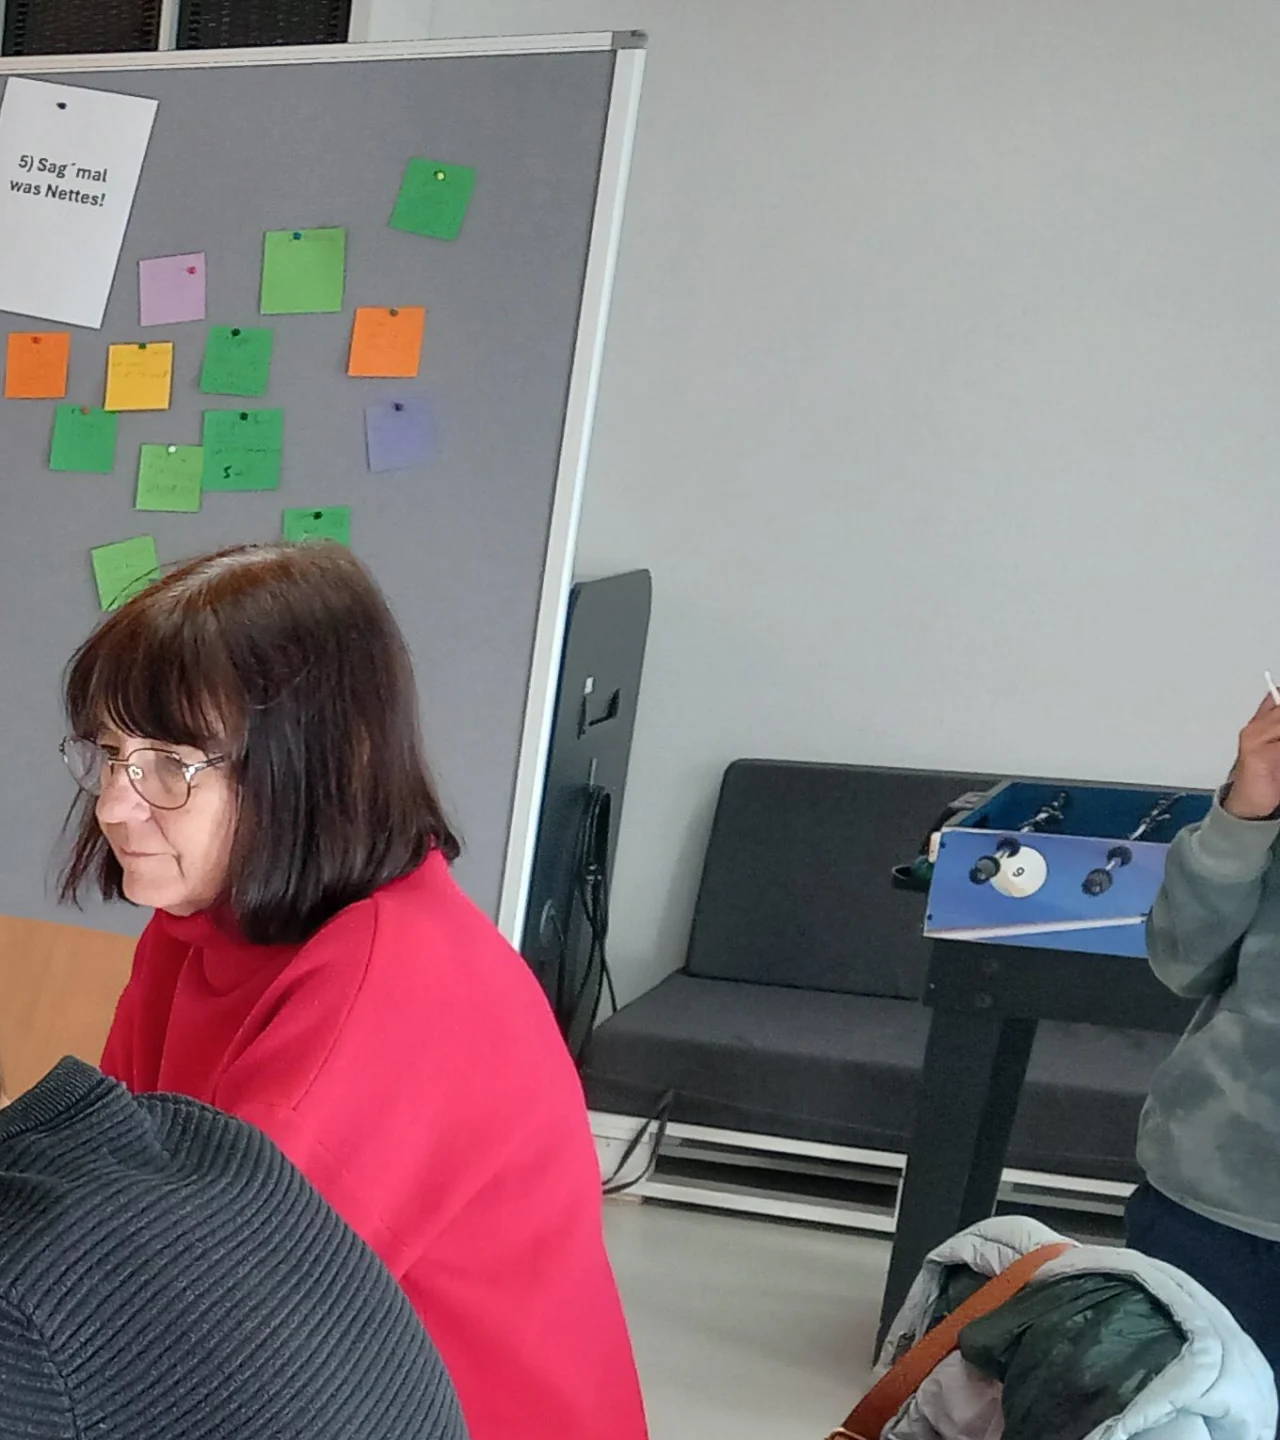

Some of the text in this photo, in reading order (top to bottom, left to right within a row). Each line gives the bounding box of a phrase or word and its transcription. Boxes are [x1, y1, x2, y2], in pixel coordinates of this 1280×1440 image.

[18, 154, 34, 173] 5)
[10, 180, 106, 208] was Nettes!
